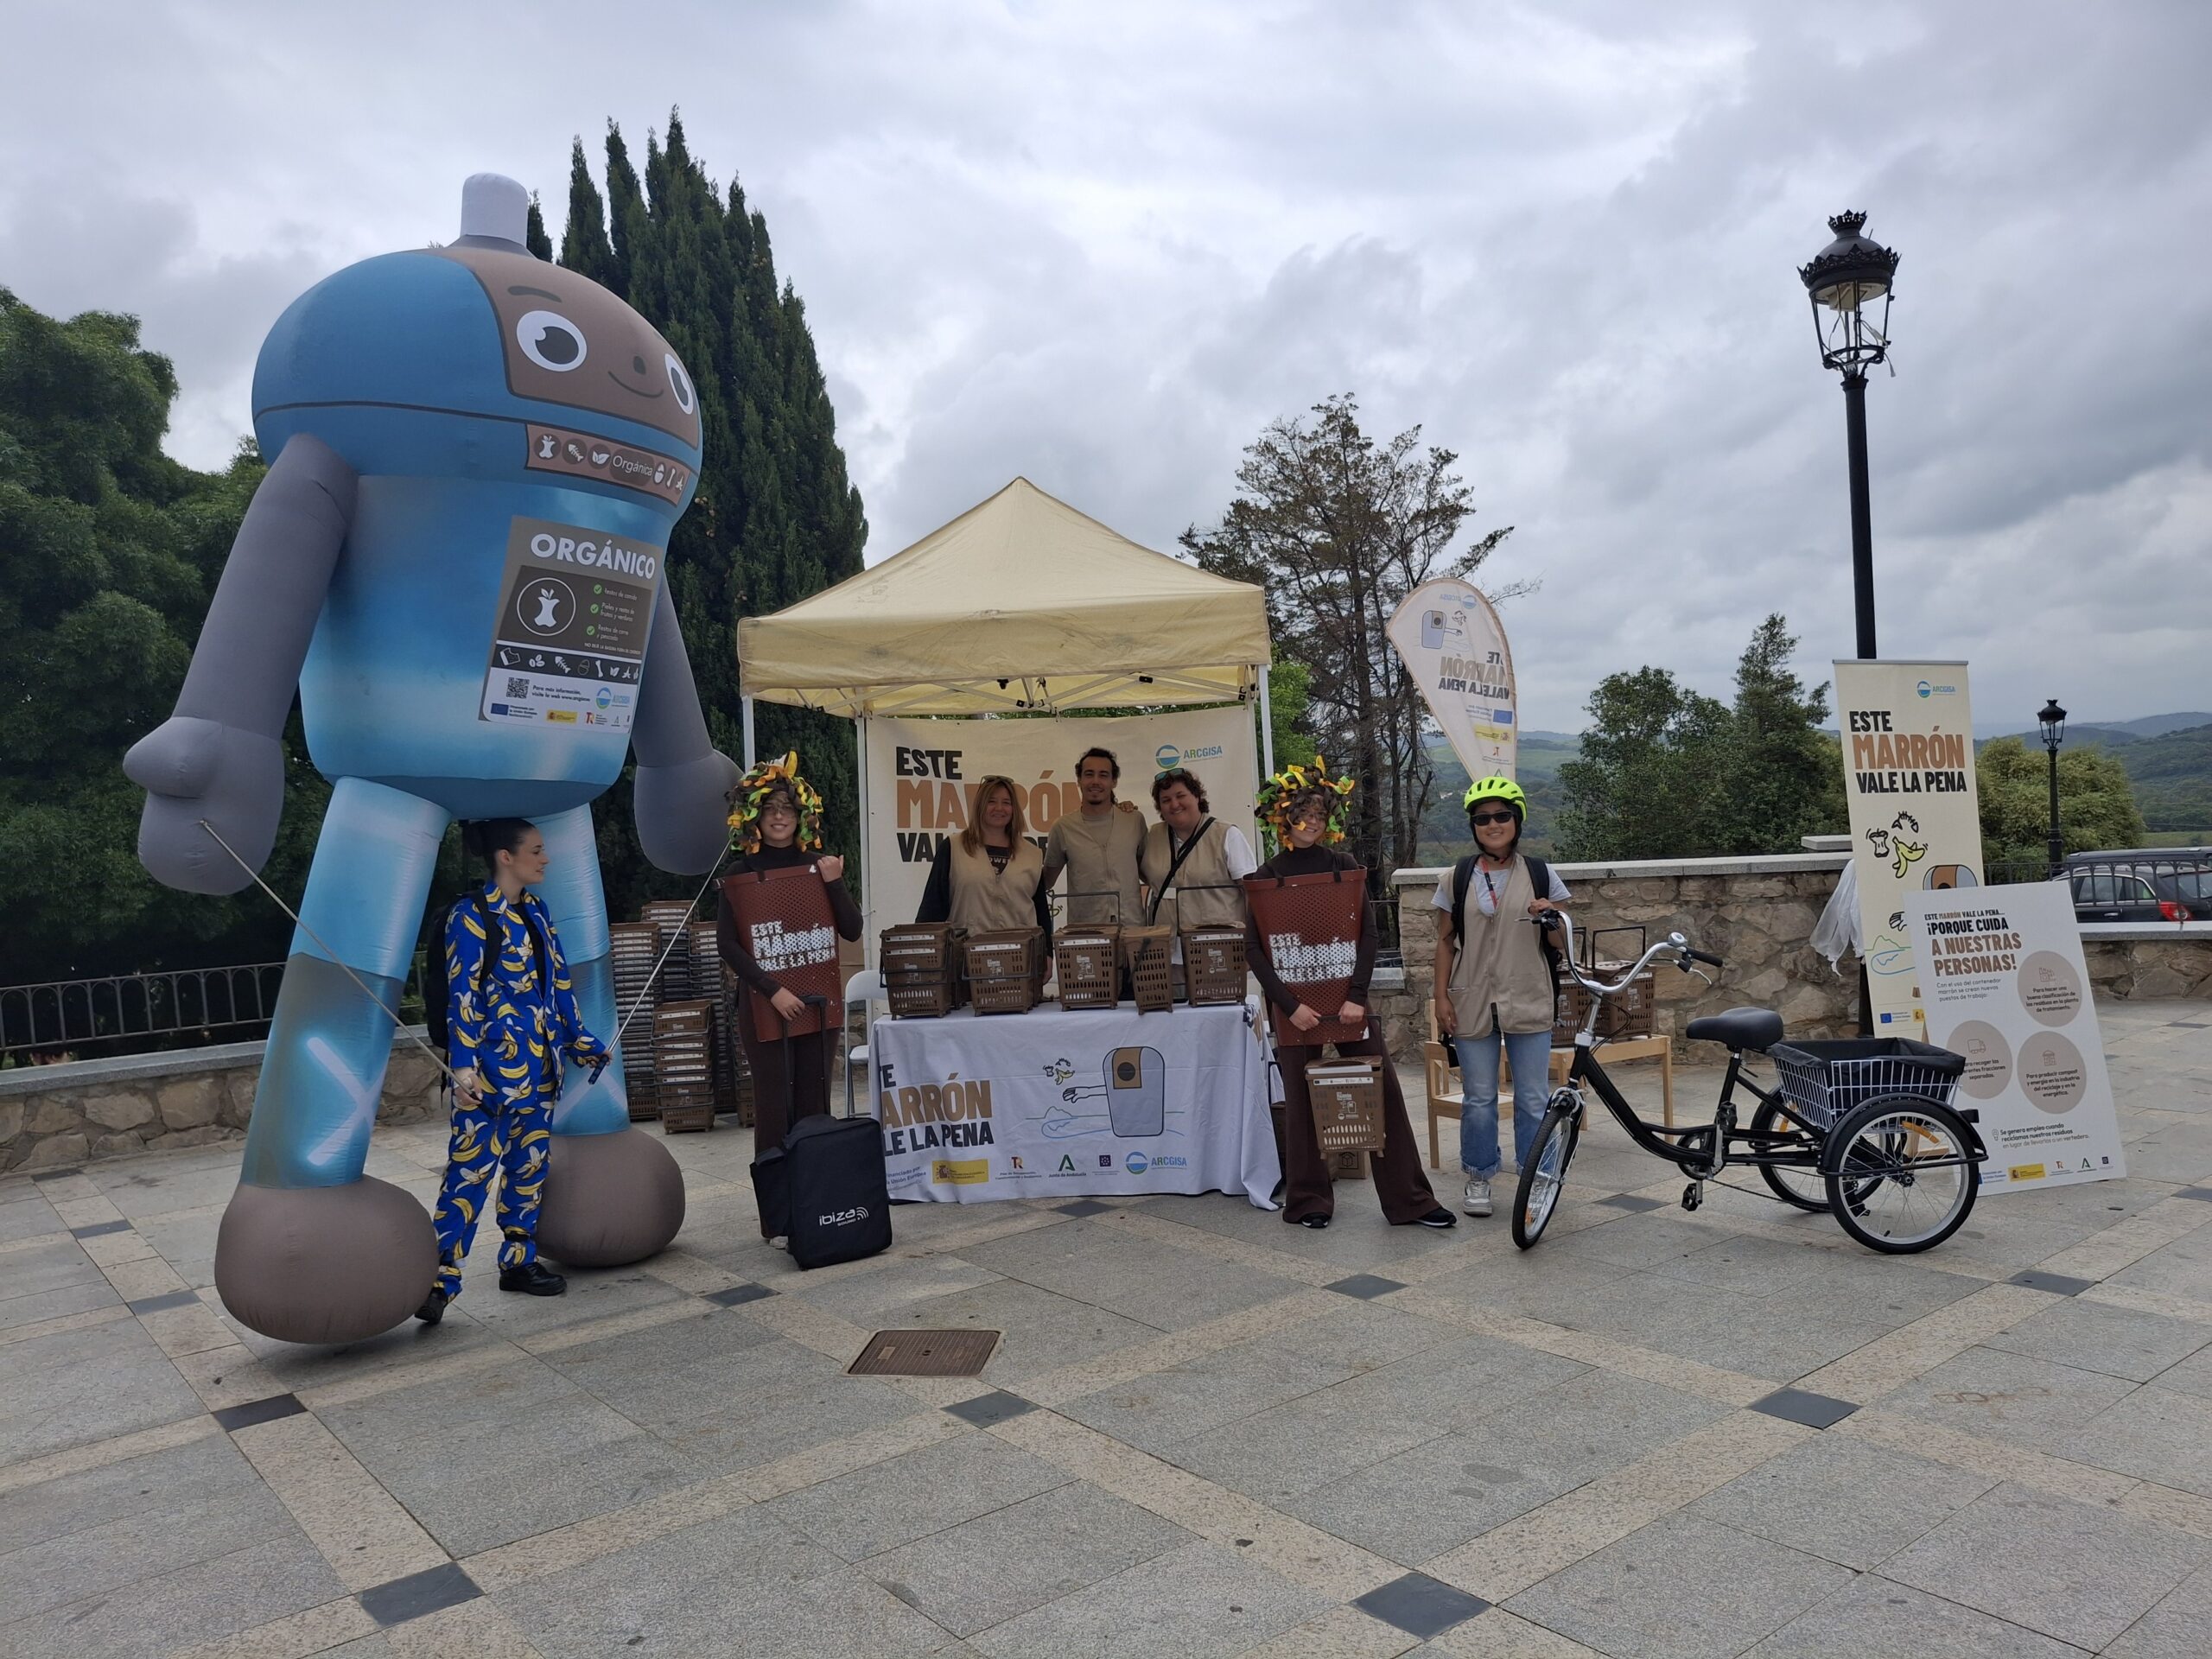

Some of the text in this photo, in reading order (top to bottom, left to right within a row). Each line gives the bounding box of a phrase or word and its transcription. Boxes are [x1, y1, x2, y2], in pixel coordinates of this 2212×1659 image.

[613, 455, 653, 476] Orgánica
[531, 539, 655, 579] ORGÁNICO
[1849, 711, 1892, 732] ESTE
[1184, 746, 1223, 759] ARCGISA
[1853, 726, 1966, 769] MARRÓN
[896, 747, 962, 779] ESTE
[1856, 772, 1967, 793] VALE LA PENA
[1939, 910, 1961, 919] MARRÓN
[751, 920, 783, 938] ESTE
[1927, 917, 2009, 935] ¡PORQUE CUIDA
[1268, 933, 1301, 948] ESTE
[1931, 932, 2022, 956] A NUESTRAS
[1934, 953, 2017, 976] PERSONAS!
[881, 1072, 993, 1130] ARRÓN
[883, 1122, 995, 1156] LE LA PENA
[1151, 1156, 1187, 1166] ARCGISA
[819, 1209, 855, 1226] ibiza
